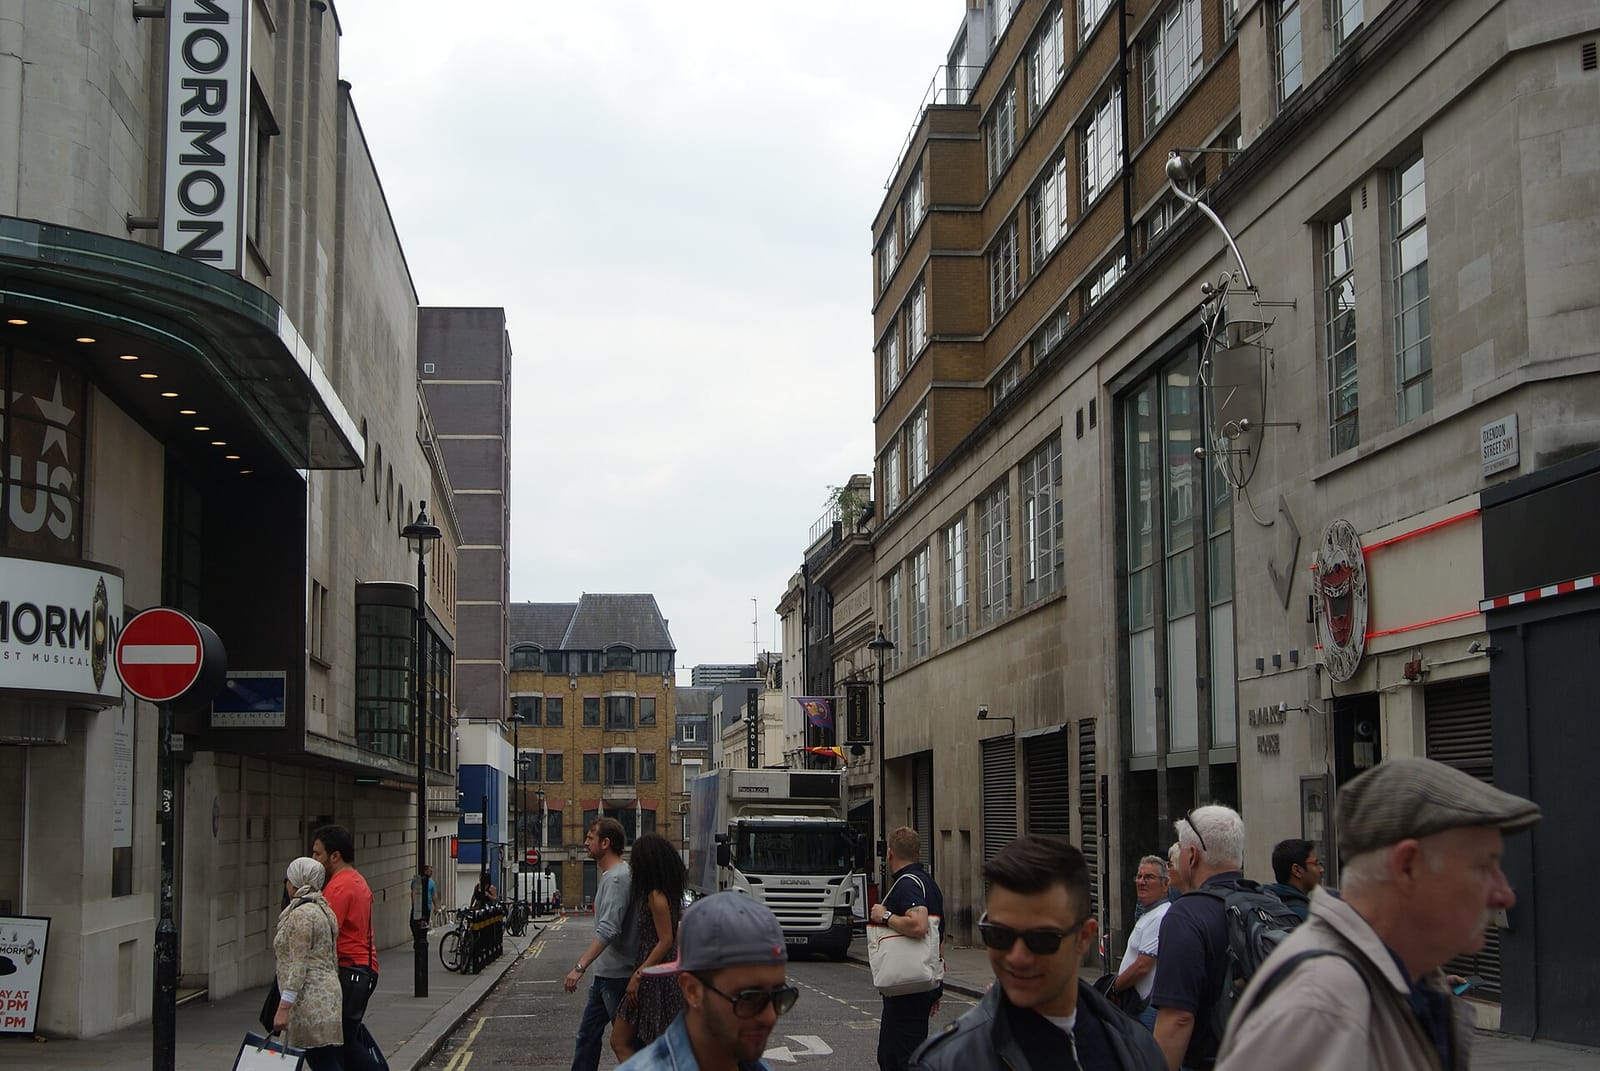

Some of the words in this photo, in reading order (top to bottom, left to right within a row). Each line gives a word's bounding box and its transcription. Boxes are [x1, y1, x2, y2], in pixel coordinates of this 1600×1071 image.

[1482, 423, 1506, 443] OXENDON
[1483, 441, 1502, 459] STREET
[1502, 437, 1514, 452] SW1
[0, 455, 75, 541] US
[32, 653, 89, 666] MUSICAL
[14, 990, 30, 999] AT
[7, 999, 29, 1011] PM
[4, 1016, 26, 1028] PM
